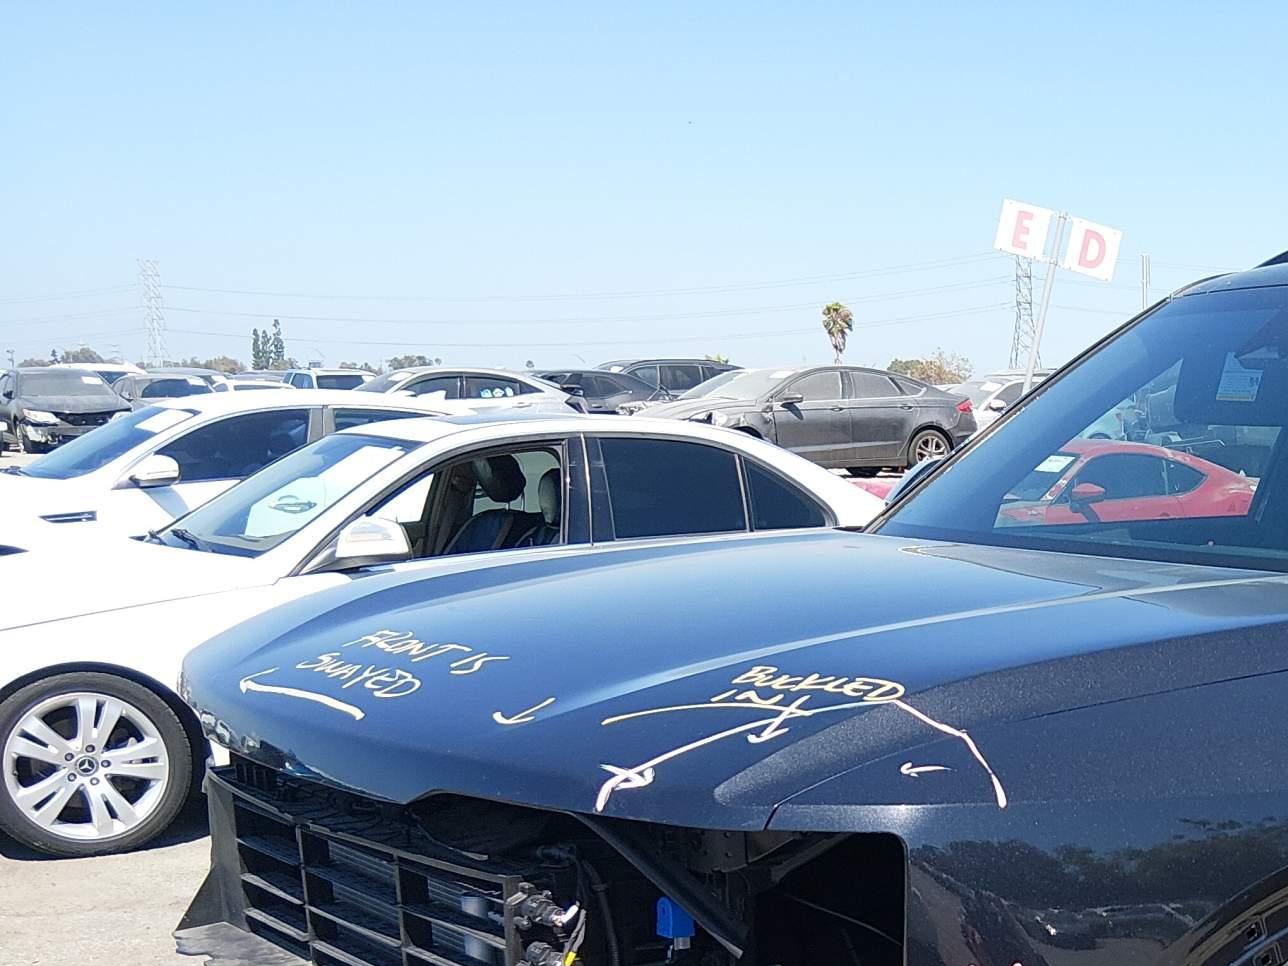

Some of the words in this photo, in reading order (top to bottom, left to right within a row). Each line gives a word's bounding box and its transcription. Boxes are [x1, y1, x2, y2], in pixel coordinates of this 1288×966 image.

[1011, 210, 1034, 250] E
[1078, 229, 1106, 269] D
[296, 652, 422, 698] SWAYED
[450, 652, 511, 675] IS
[731, 665, 906, 701] BUCKLED
